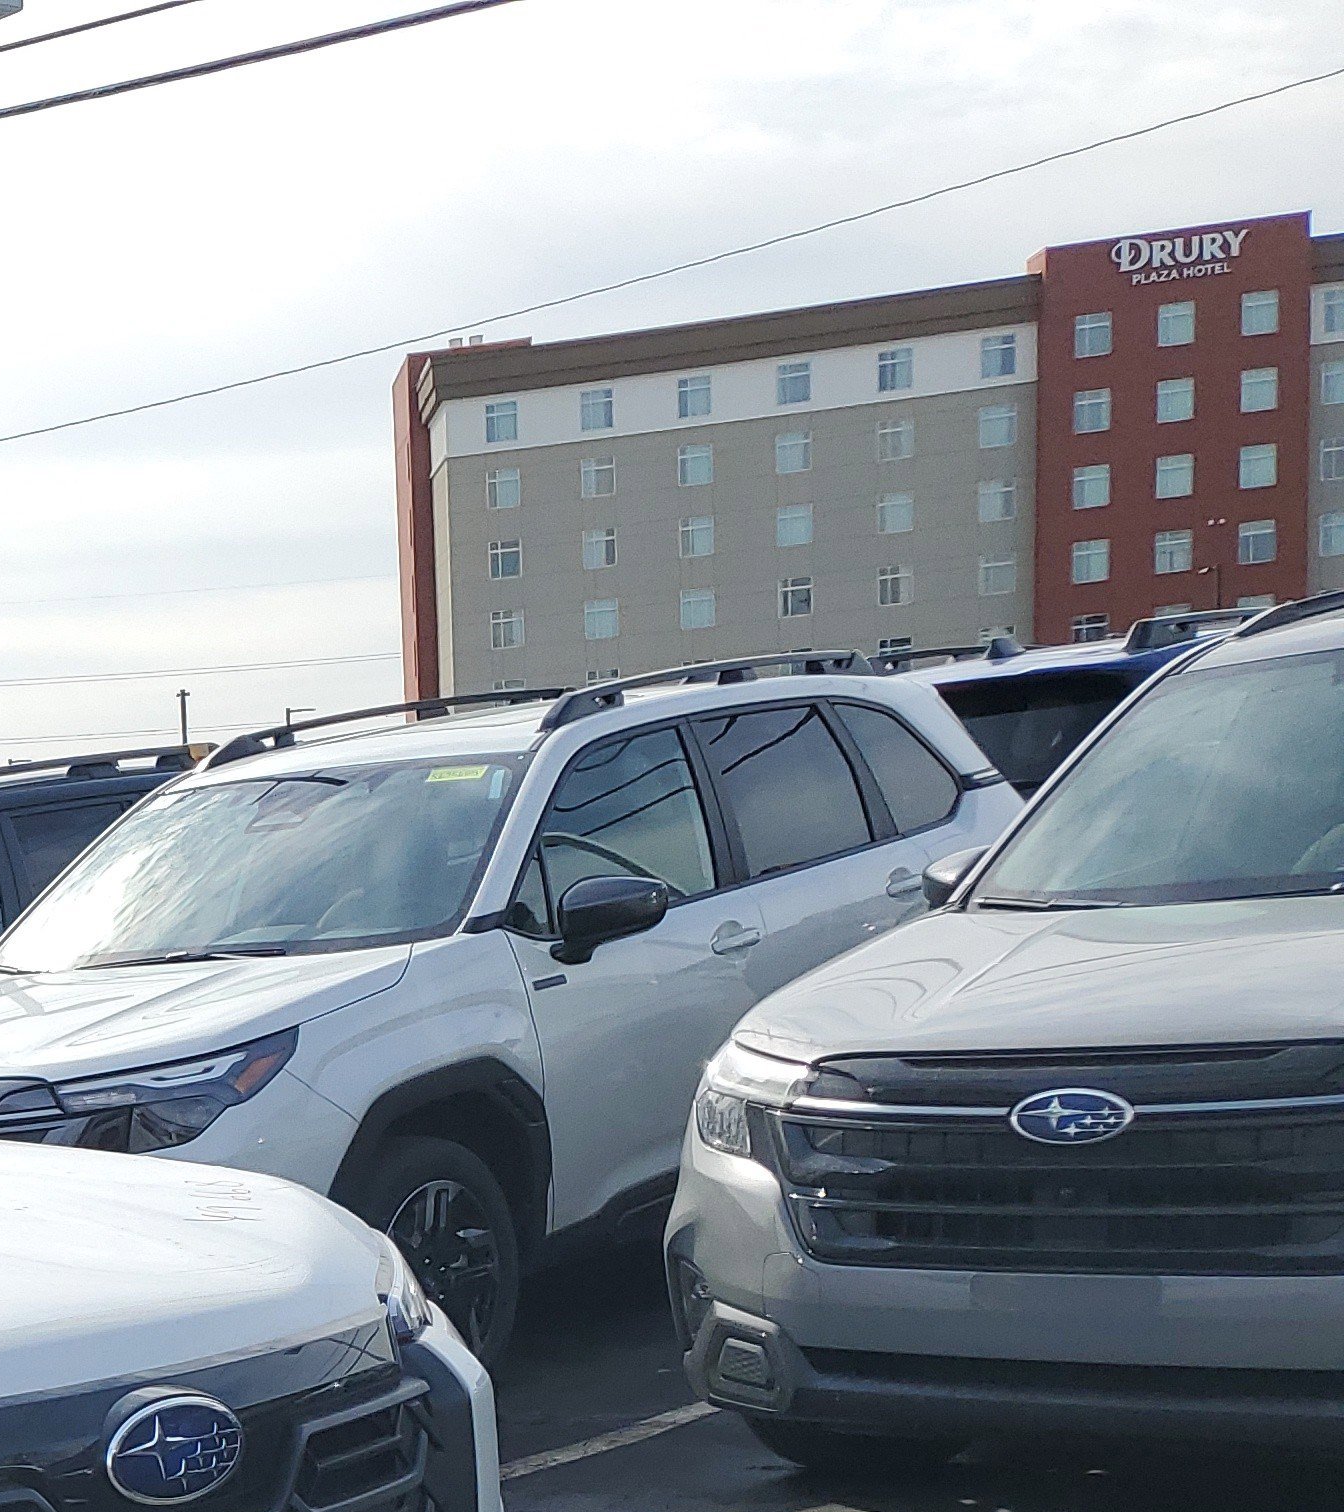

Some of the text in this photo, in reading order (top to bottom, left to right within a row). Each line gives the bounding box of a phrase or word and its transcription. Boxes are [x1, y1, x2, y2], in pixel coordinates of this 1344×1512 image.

[1112, 229, 1249, 272] DRURY
[1132, 263, 1232, 286] PLAZA HOTEL
